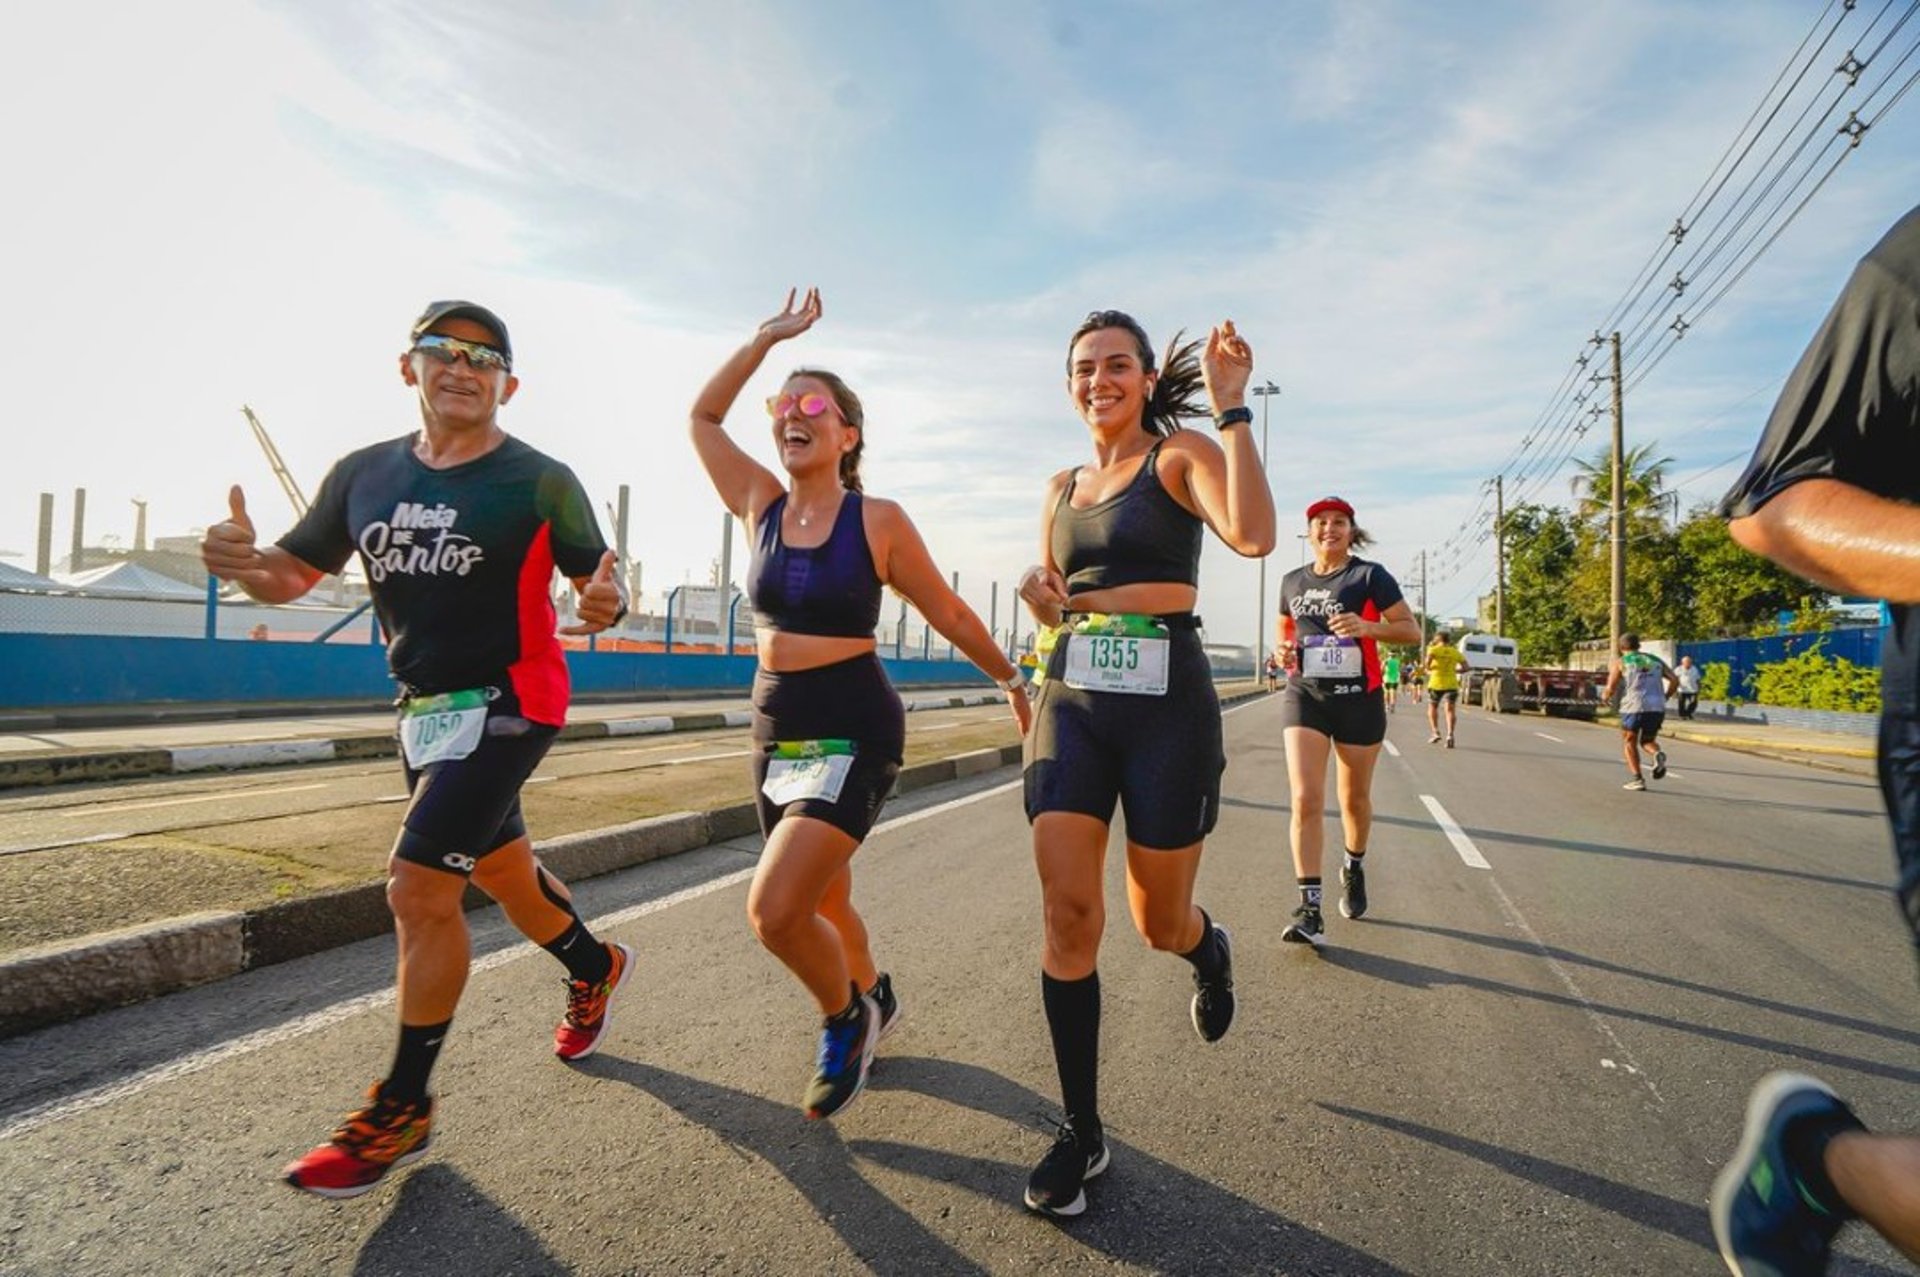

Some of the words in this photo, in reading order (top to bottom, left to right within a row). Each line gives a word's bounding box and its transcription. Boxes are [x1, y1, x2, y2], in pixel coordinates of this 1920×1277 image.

[391, 502, 457, 530] Meia
[360, 521, 484, 582] Santos
[392, 530, 413, 545] DE
[1090, 638, 1138, 670] 1355
[1322, 648, 1343, 665] 418
